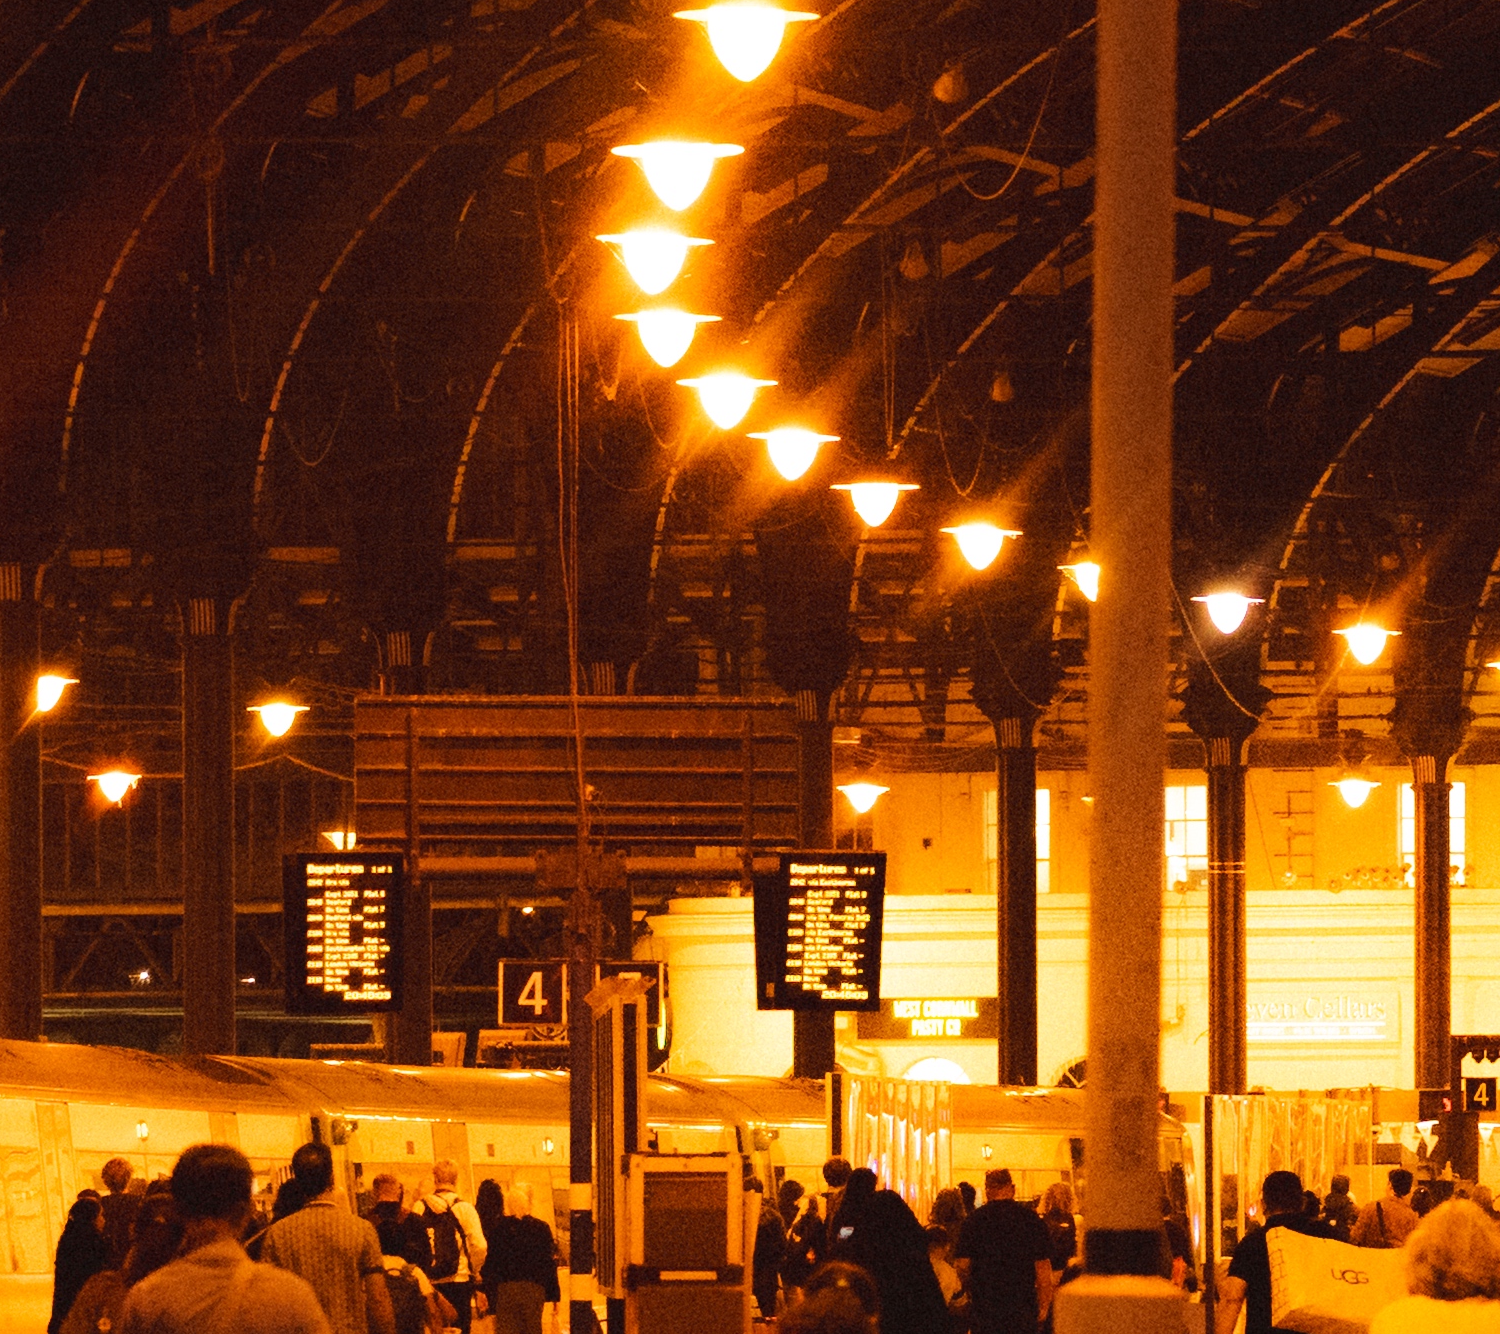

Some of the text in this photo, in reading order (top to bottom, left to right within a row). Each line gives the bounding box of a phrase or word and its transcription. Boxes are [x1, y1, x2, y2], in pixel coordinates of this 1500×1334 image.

[307, 864, 364, 875] Departures
[790, 864, 847, 874] Departures
[518, 971, 548, 1015] 4
[893, 1000, 979, 1018] WEST CORNWALL
[1246, 996, 1387, 1021] even Cellars
[911, 1019, 944, 1036] PASTY
[1473, 1082, 1490, 1107] 4
[1331, 1268, 1369, 1285] UGG
